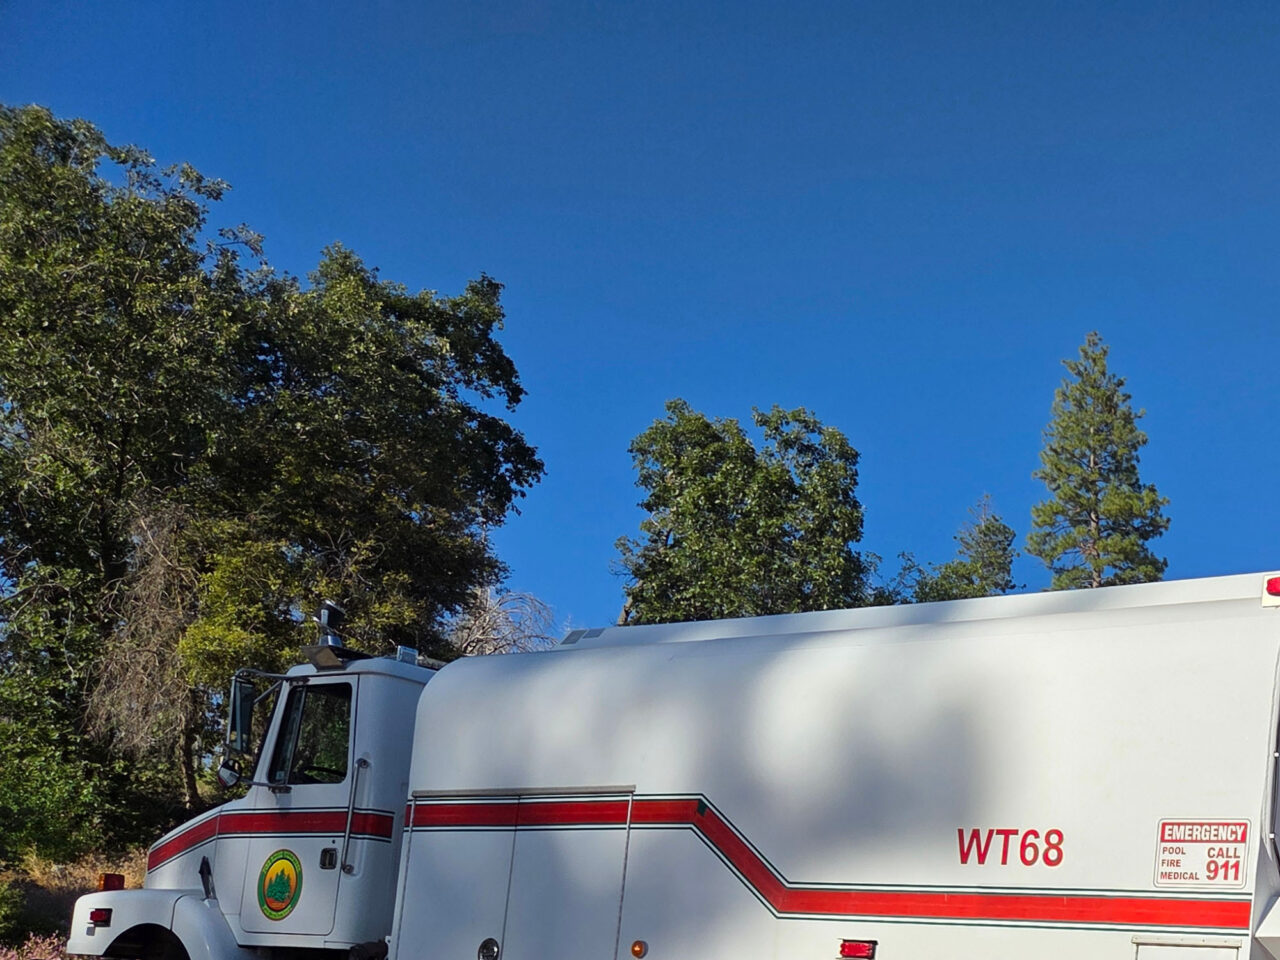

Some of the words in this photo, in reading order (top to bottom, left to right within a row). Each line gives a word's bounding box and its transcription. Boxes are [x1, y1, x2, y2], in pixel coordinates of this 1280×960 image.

[1163, 824, 1245, 841] EMERGENCY
[957, 828, 1064, 867] WT68
[1162, 846, 1186, 855] POOL
[1207, 847, 1241, 859] CALL
[1161, 859, 1181, 867] FIRE
[1160, 871, 1200, 881] MEDICAL
[1205, 859, 1241, 881] 911
